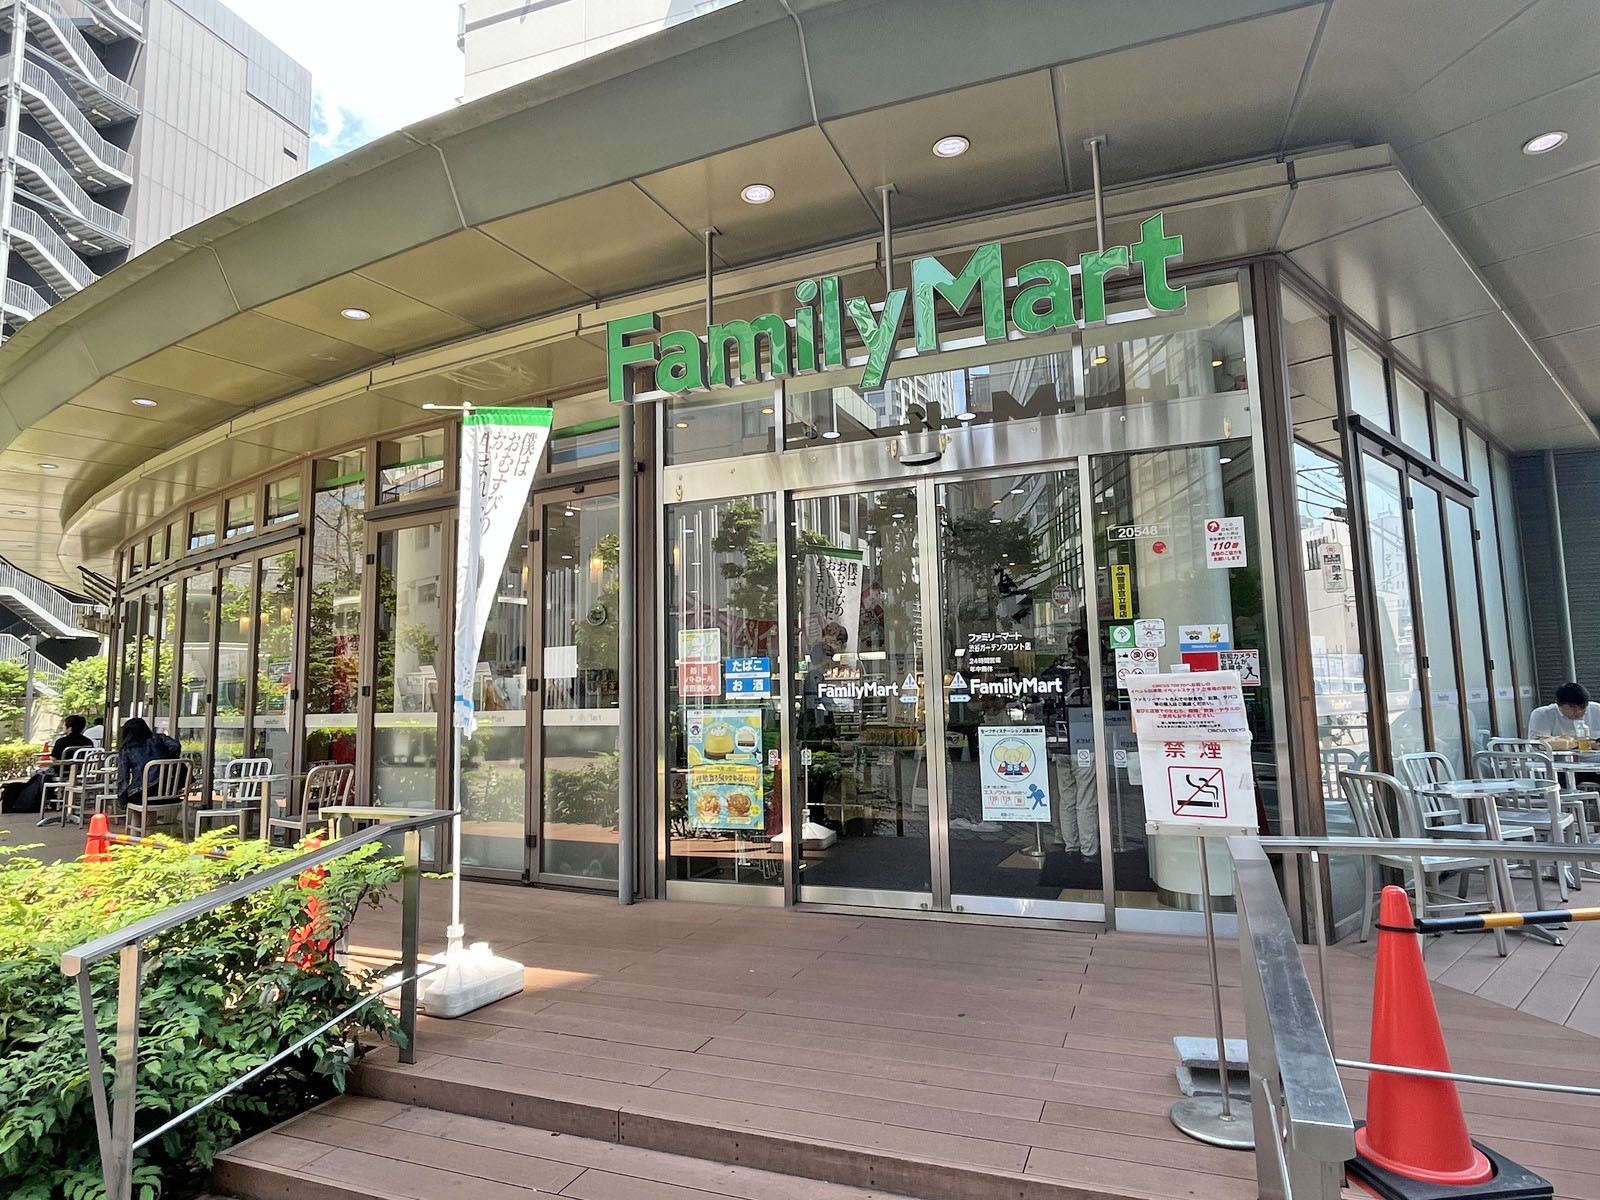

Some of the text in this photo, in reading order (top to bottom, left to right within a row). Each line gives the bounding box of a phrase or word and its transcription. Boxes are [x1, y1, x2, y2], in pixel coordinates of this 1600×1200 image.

[607, 212, 1187, 404] FamilyMart
[514, 431, 538, 476] 僕は
[1117, 526, 1158, 538] 20548
[834, 560, 847, 617] おむすびの
[968, 631, 1023, 644] ファミリーマート
[968, 642, 1031, 653] 渋谷ガーデンフロント店
[732, 659, 763, 672] たばこ
[968, 656, 1002, 665] 24時間営業
[1221, 658, 1247, 666] セコムが
[732, 678, 764, 692] お酒
[817, 681, 899, 699] FamilyMart
[970, 677, 1063, 697] FamilyMart
[1163, 741, 1223, 760] 禁煙
